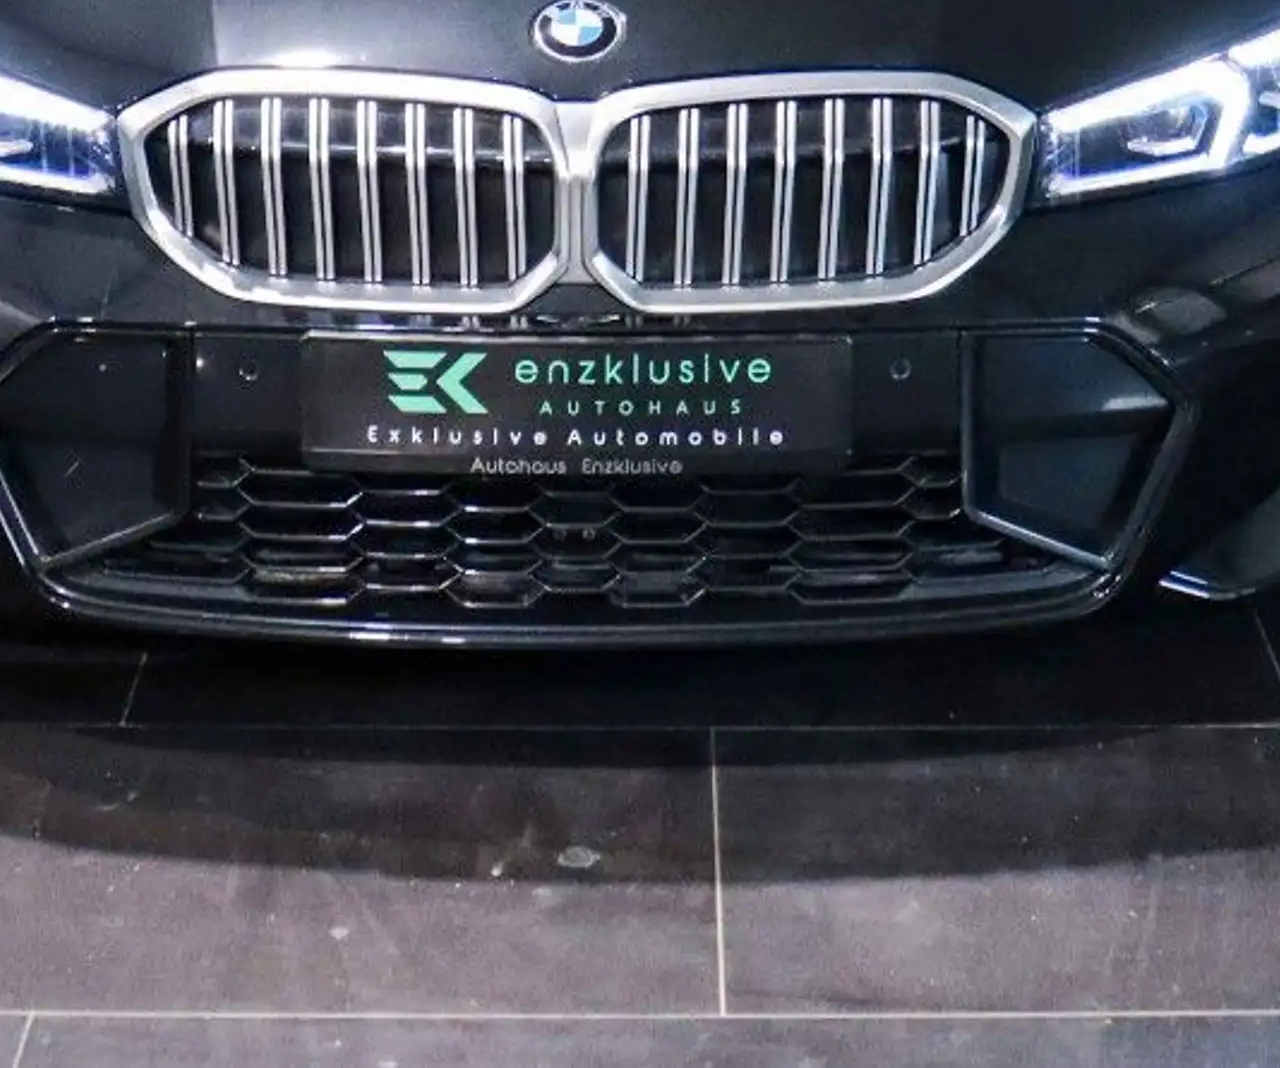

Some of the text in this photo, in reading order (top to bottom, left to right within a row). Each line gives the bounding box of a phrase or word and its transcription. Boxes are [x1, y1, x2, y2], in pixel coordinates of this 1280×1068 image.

[515, 353, 772, 385] enzklusive
[539, 399, 743, 416] AUTOHAUS
[367, 425, 784, 446] Exklusive Automobile
[470, 457, 683, 474] Autohaus Enzklusive
